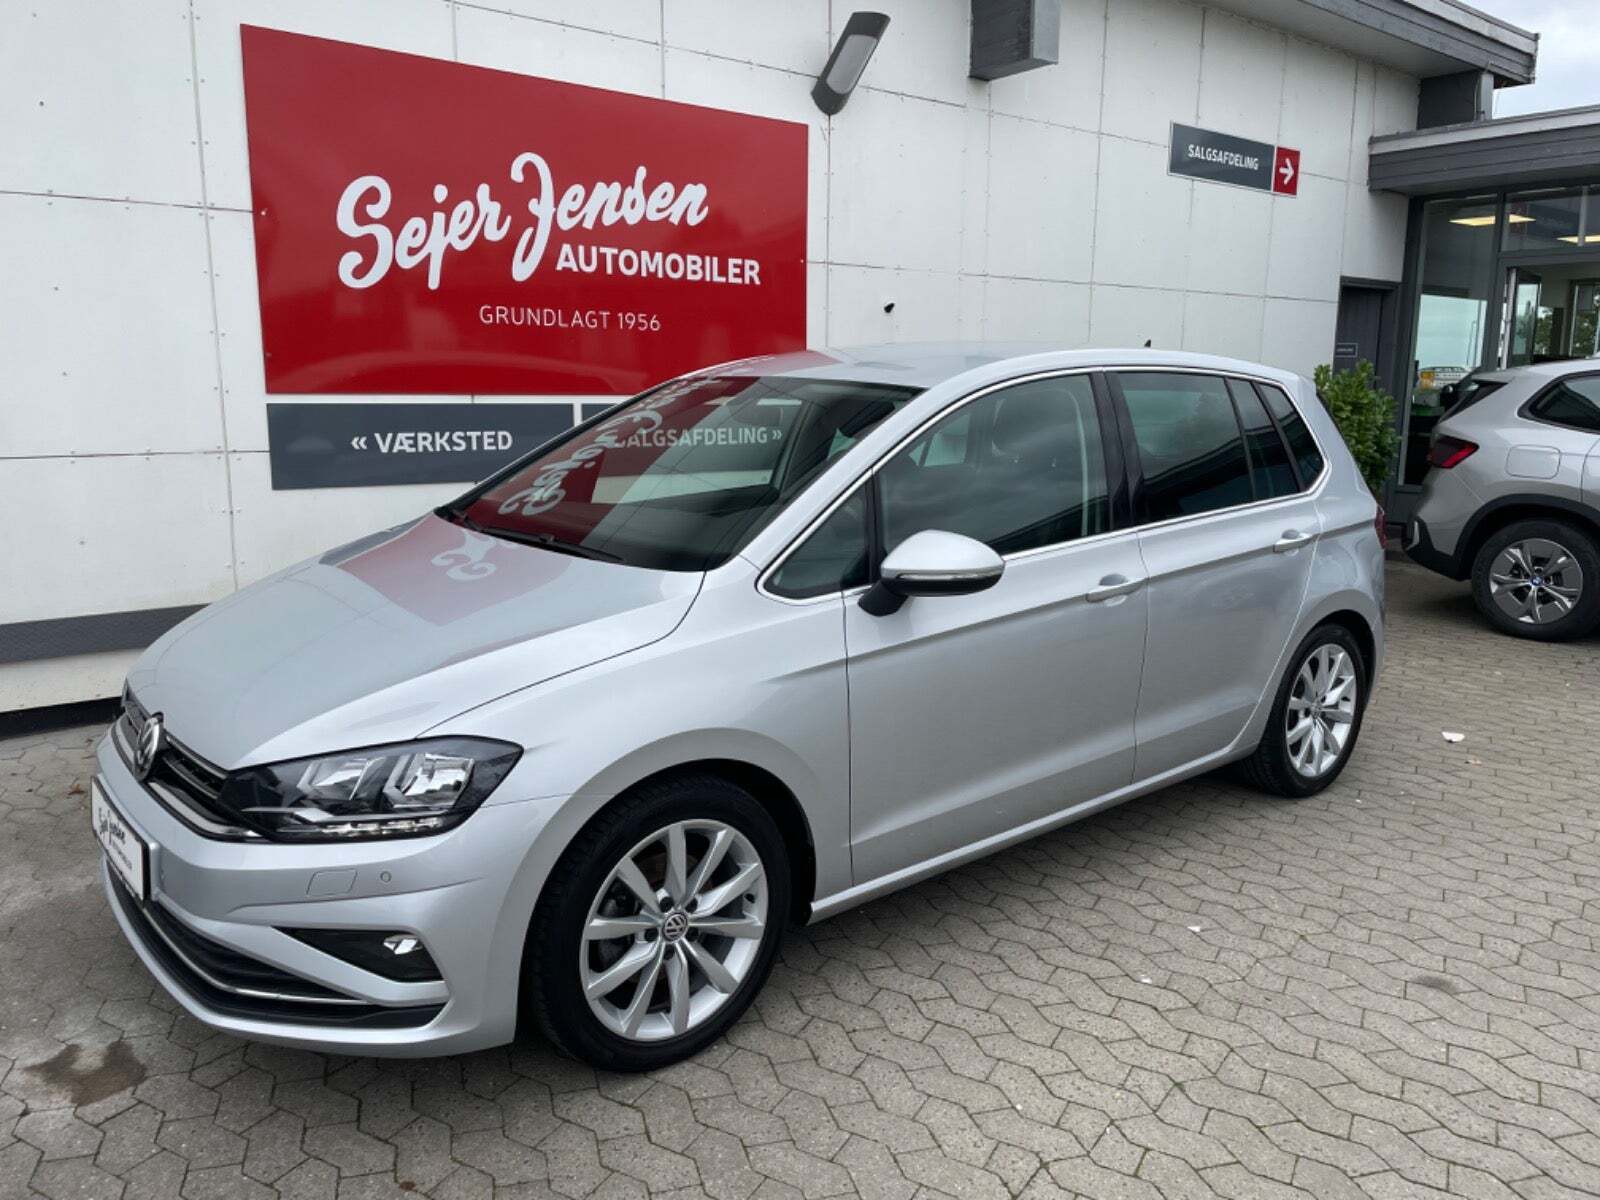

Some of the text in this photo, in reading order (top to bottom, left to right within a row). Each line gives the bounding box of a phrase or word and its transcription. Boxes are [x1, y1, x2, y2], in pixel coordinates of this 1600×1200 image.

[1187, 144, 1259, 170] SALGSAFDELING
[336, 152, 709, 290] Sejer Jensen
[556, 244, 761, 285] AUTOMOBILER
[479, 305, 661, 332] GRUNDLAGT 1956
[374, 430, 513, 453] VÆRKSTED
[614, 426, 768, 448] ALGSAFDELING
